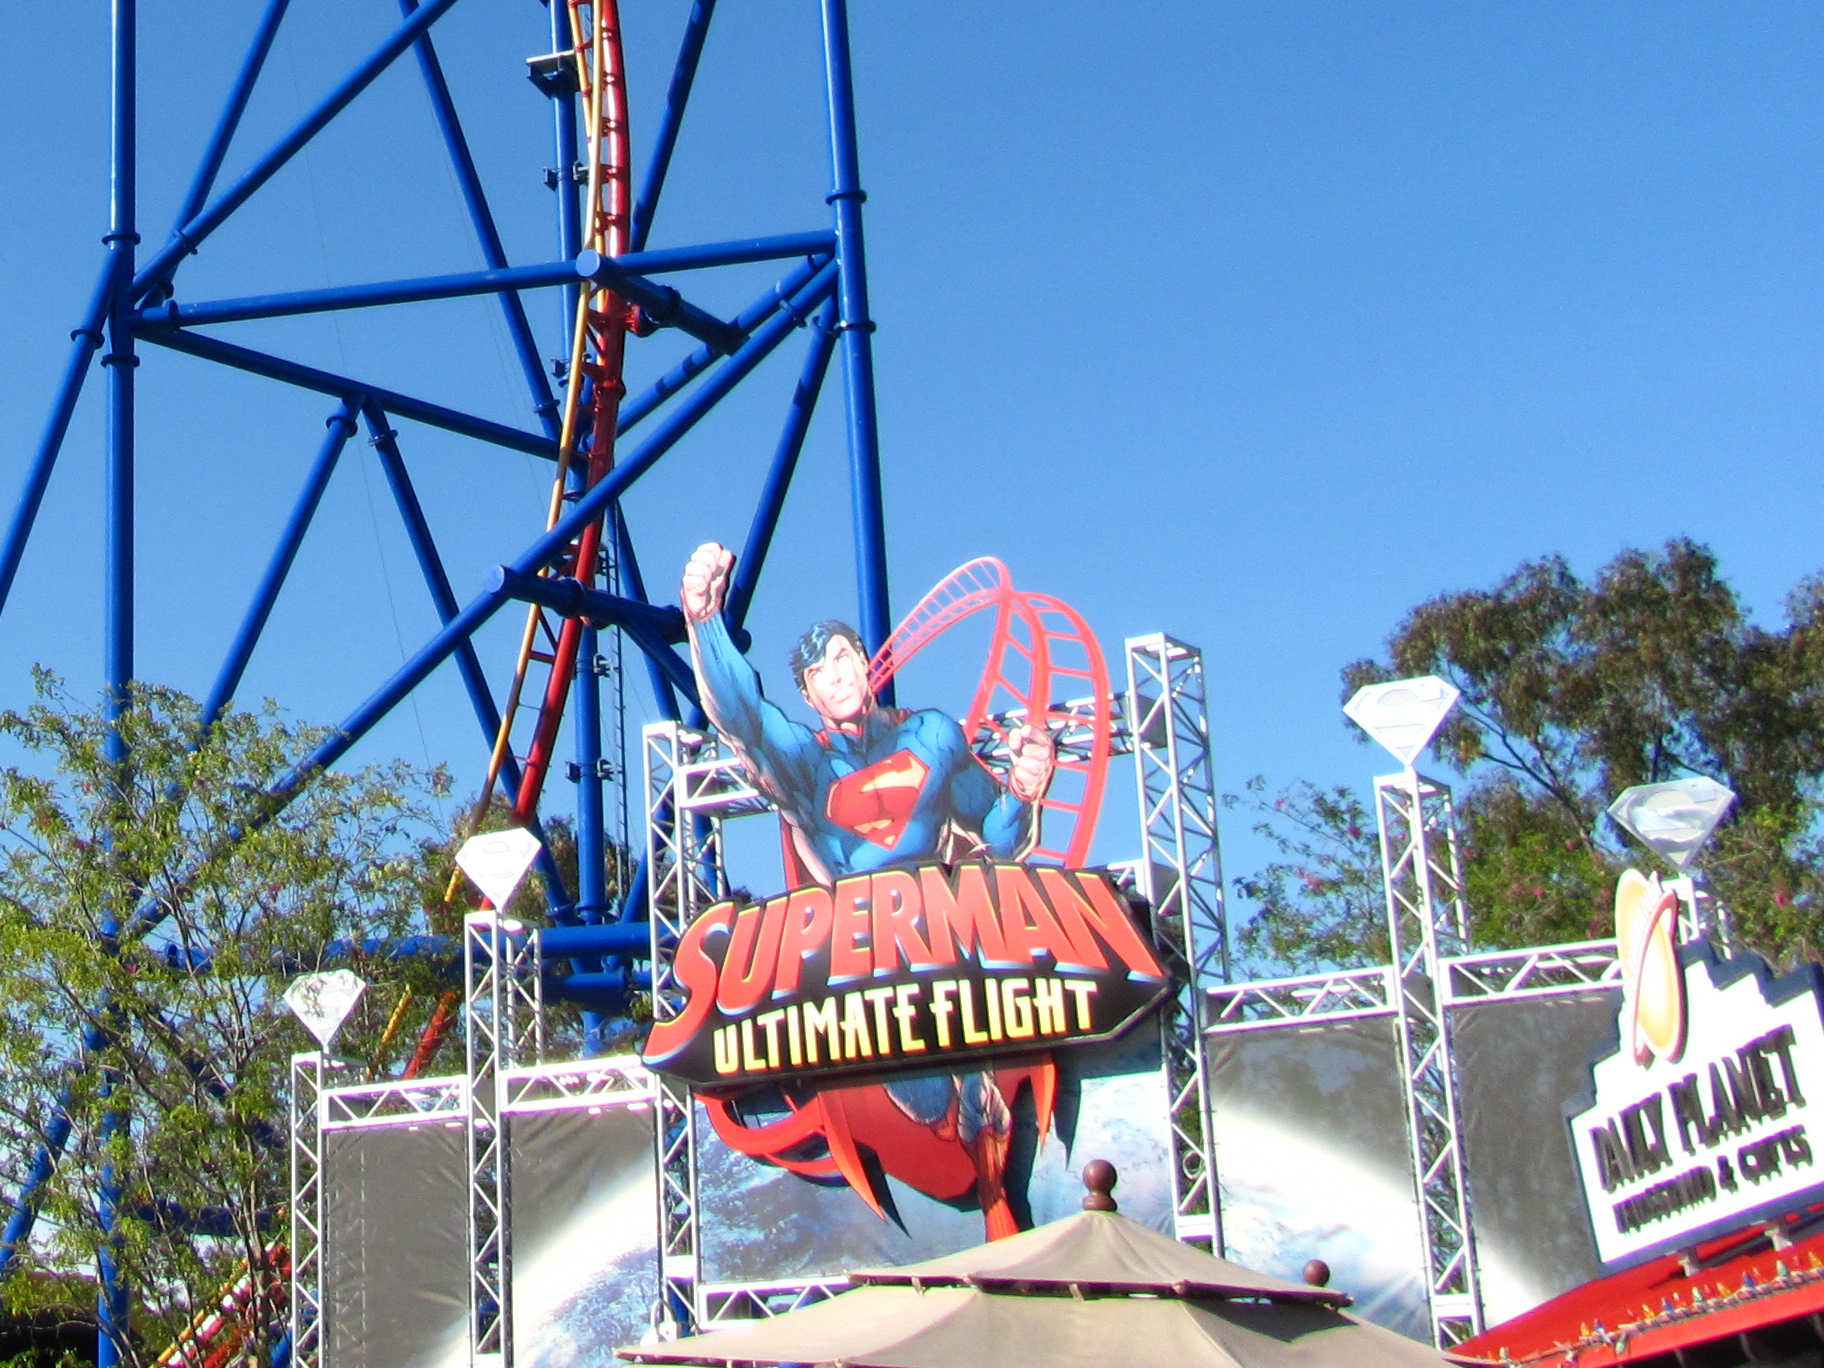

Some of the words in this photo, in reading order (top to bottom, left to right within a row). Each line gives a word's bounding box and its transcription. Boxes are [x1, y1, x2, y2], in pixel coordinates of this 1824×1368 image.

[642, 865, 1170, 1065] SUPERMAN
[713, 983, 927, 1075] ULTIMATE
[929, 977, 1098, 1051] FLIGHT
[1588, 1091, 1674, 1194] DAILY
[1667, 1023, 1807, 1156] PLANET
[1738, 1124, 1814, 1186] GIFTS
